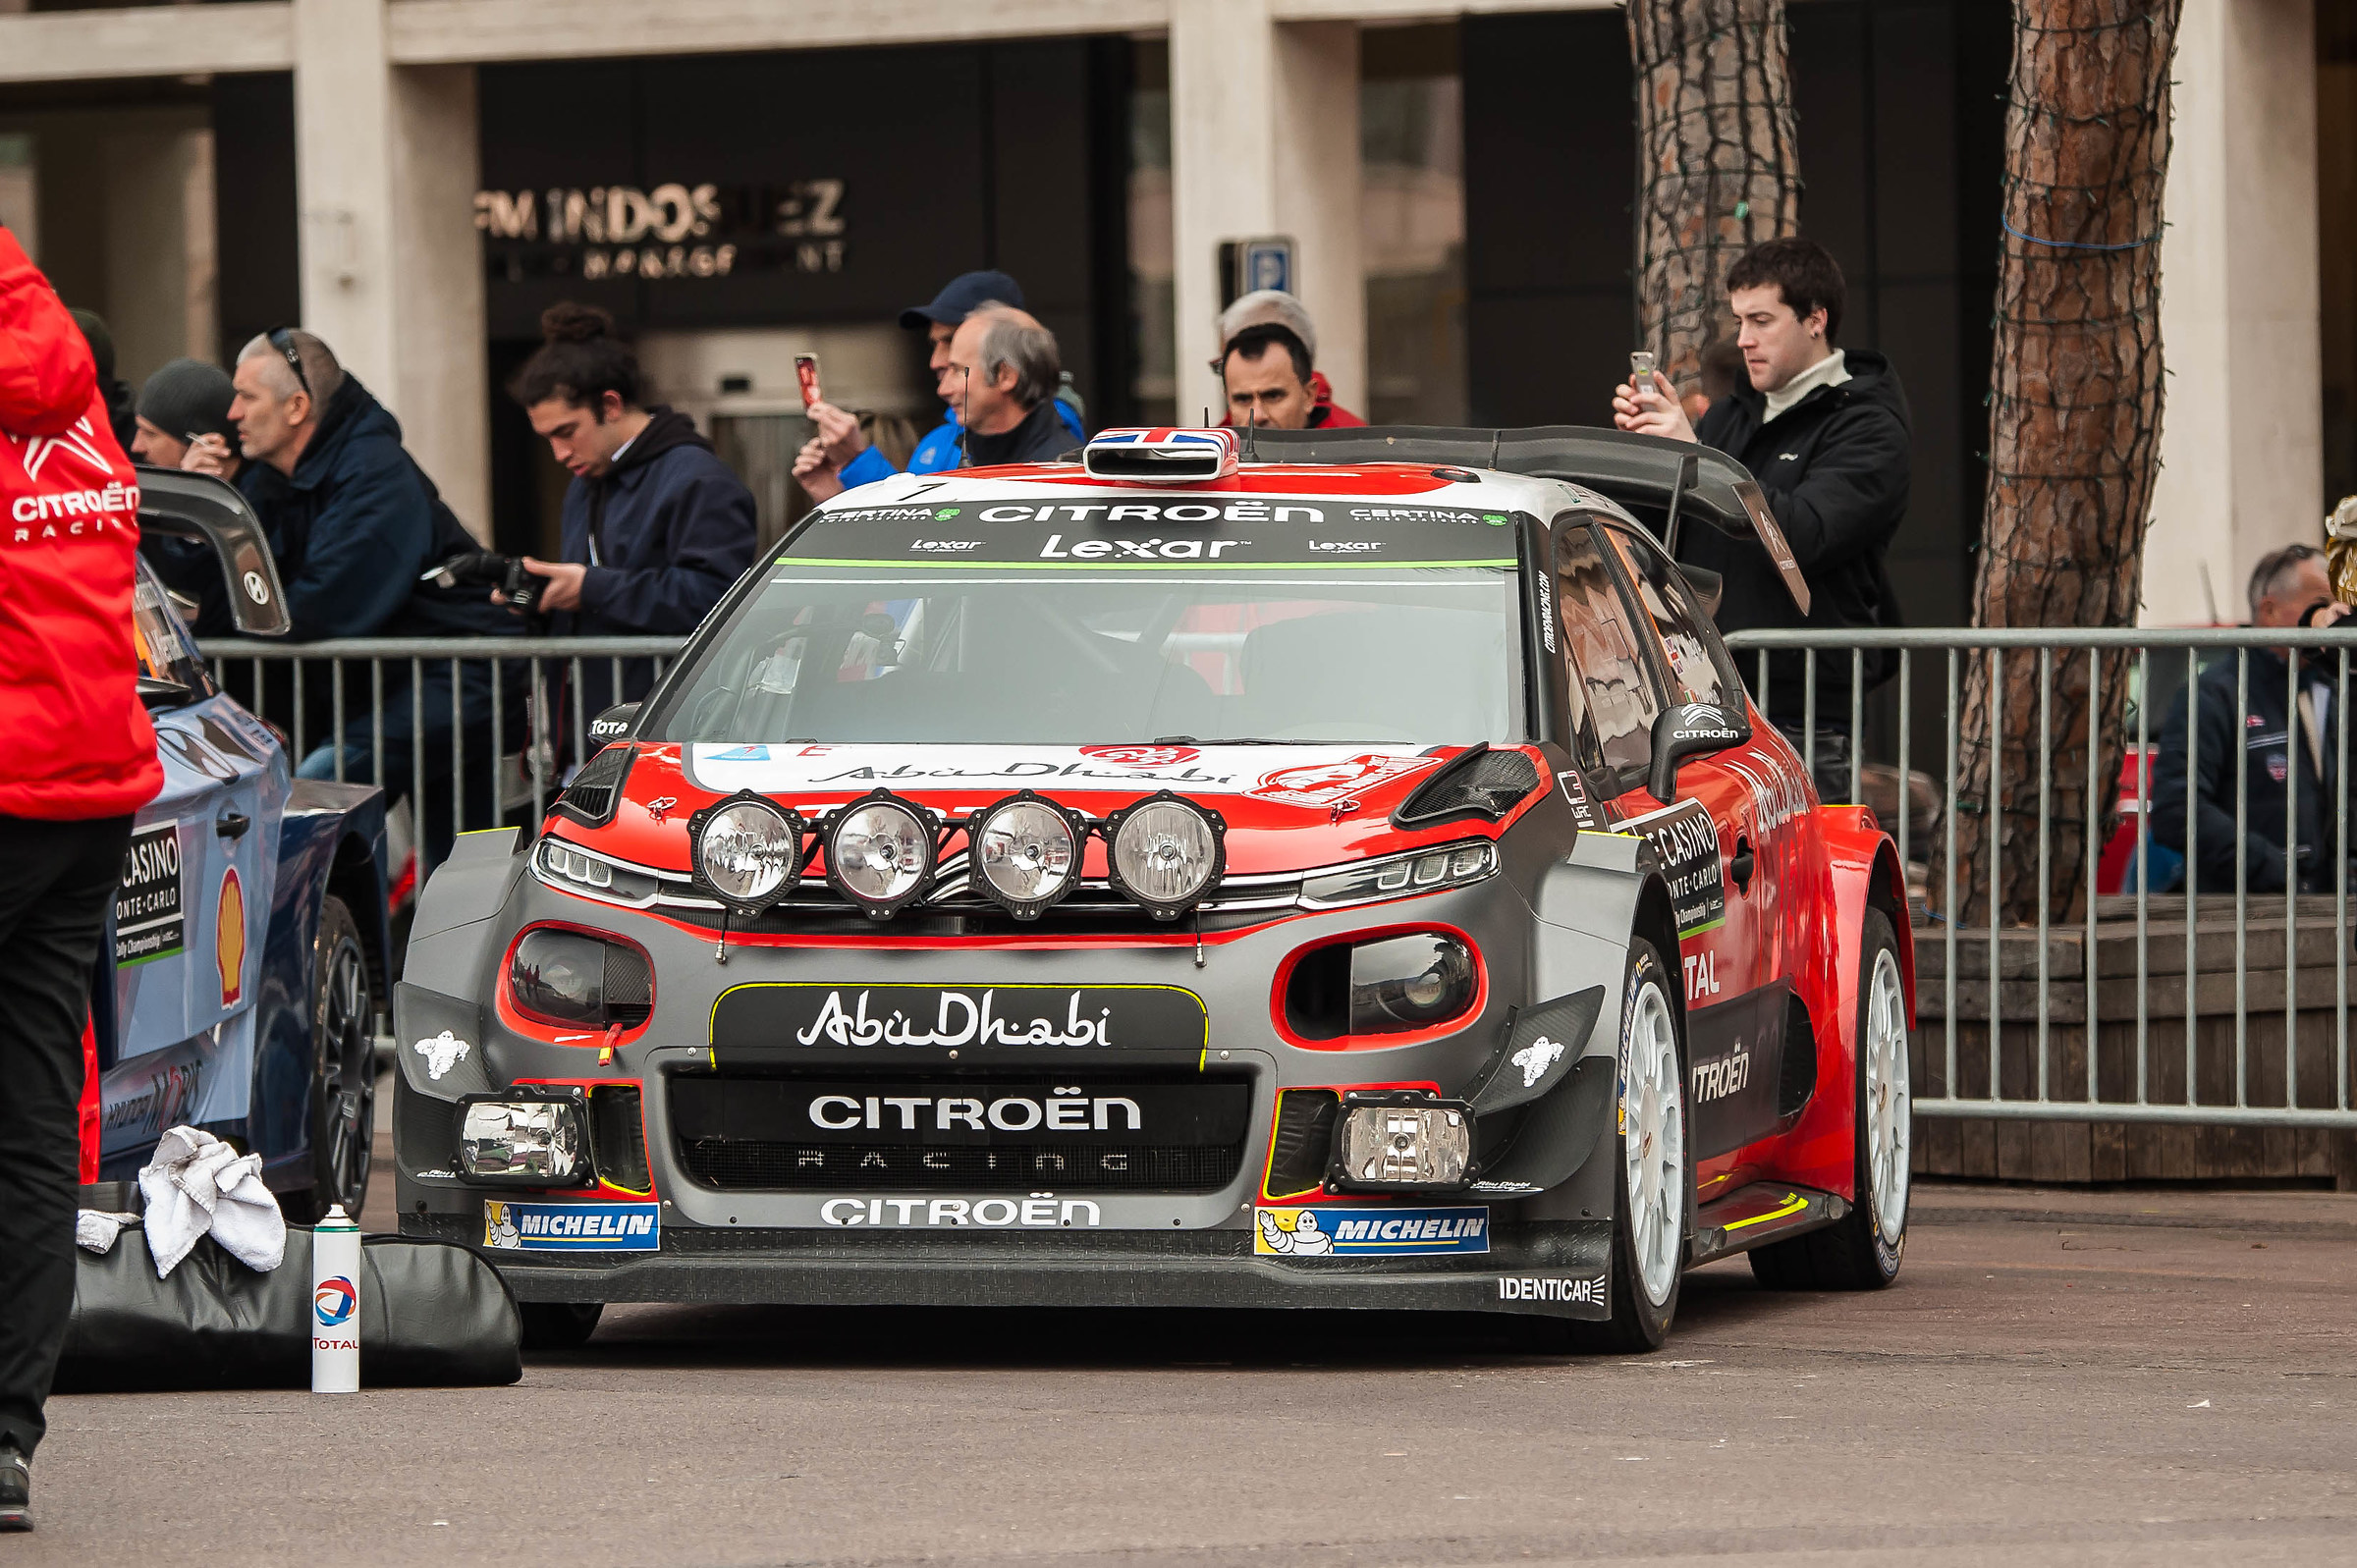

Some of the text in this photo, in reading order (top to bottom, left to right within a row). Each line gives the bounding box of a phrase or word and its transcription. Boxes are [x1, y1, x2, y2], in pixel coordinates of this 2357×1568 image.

[897, 482, 949, 503] 7
[821, 507, 933, 520] CERTINA
[978, 500, 1325, 523] CITROËN
[1348, 508, 1480, 522] CERTINA
[910, 538, 982, 550] Lexar
[591, 719, 629, 735] TOTA
[1672, 727, 1739, 739] CITROËN
[1659, 812, 1715, 867] CASINO
[1684, 949, 1720, 1000] TAL
[1619, 972, 1639, 1086] MICHELIN
[1691, 1042, 1750, 1104] ITROËN
[808, 1086, 1141, 1131] CITROËN
[820, 1191, 1101, 1226] CITROËN
[521, 1215, 655, 1236] MICHELIN
[1334, 1217, 1485, 1240] MICHELIN
[1499, 1277, 1592, 1303] IDENTICAR
